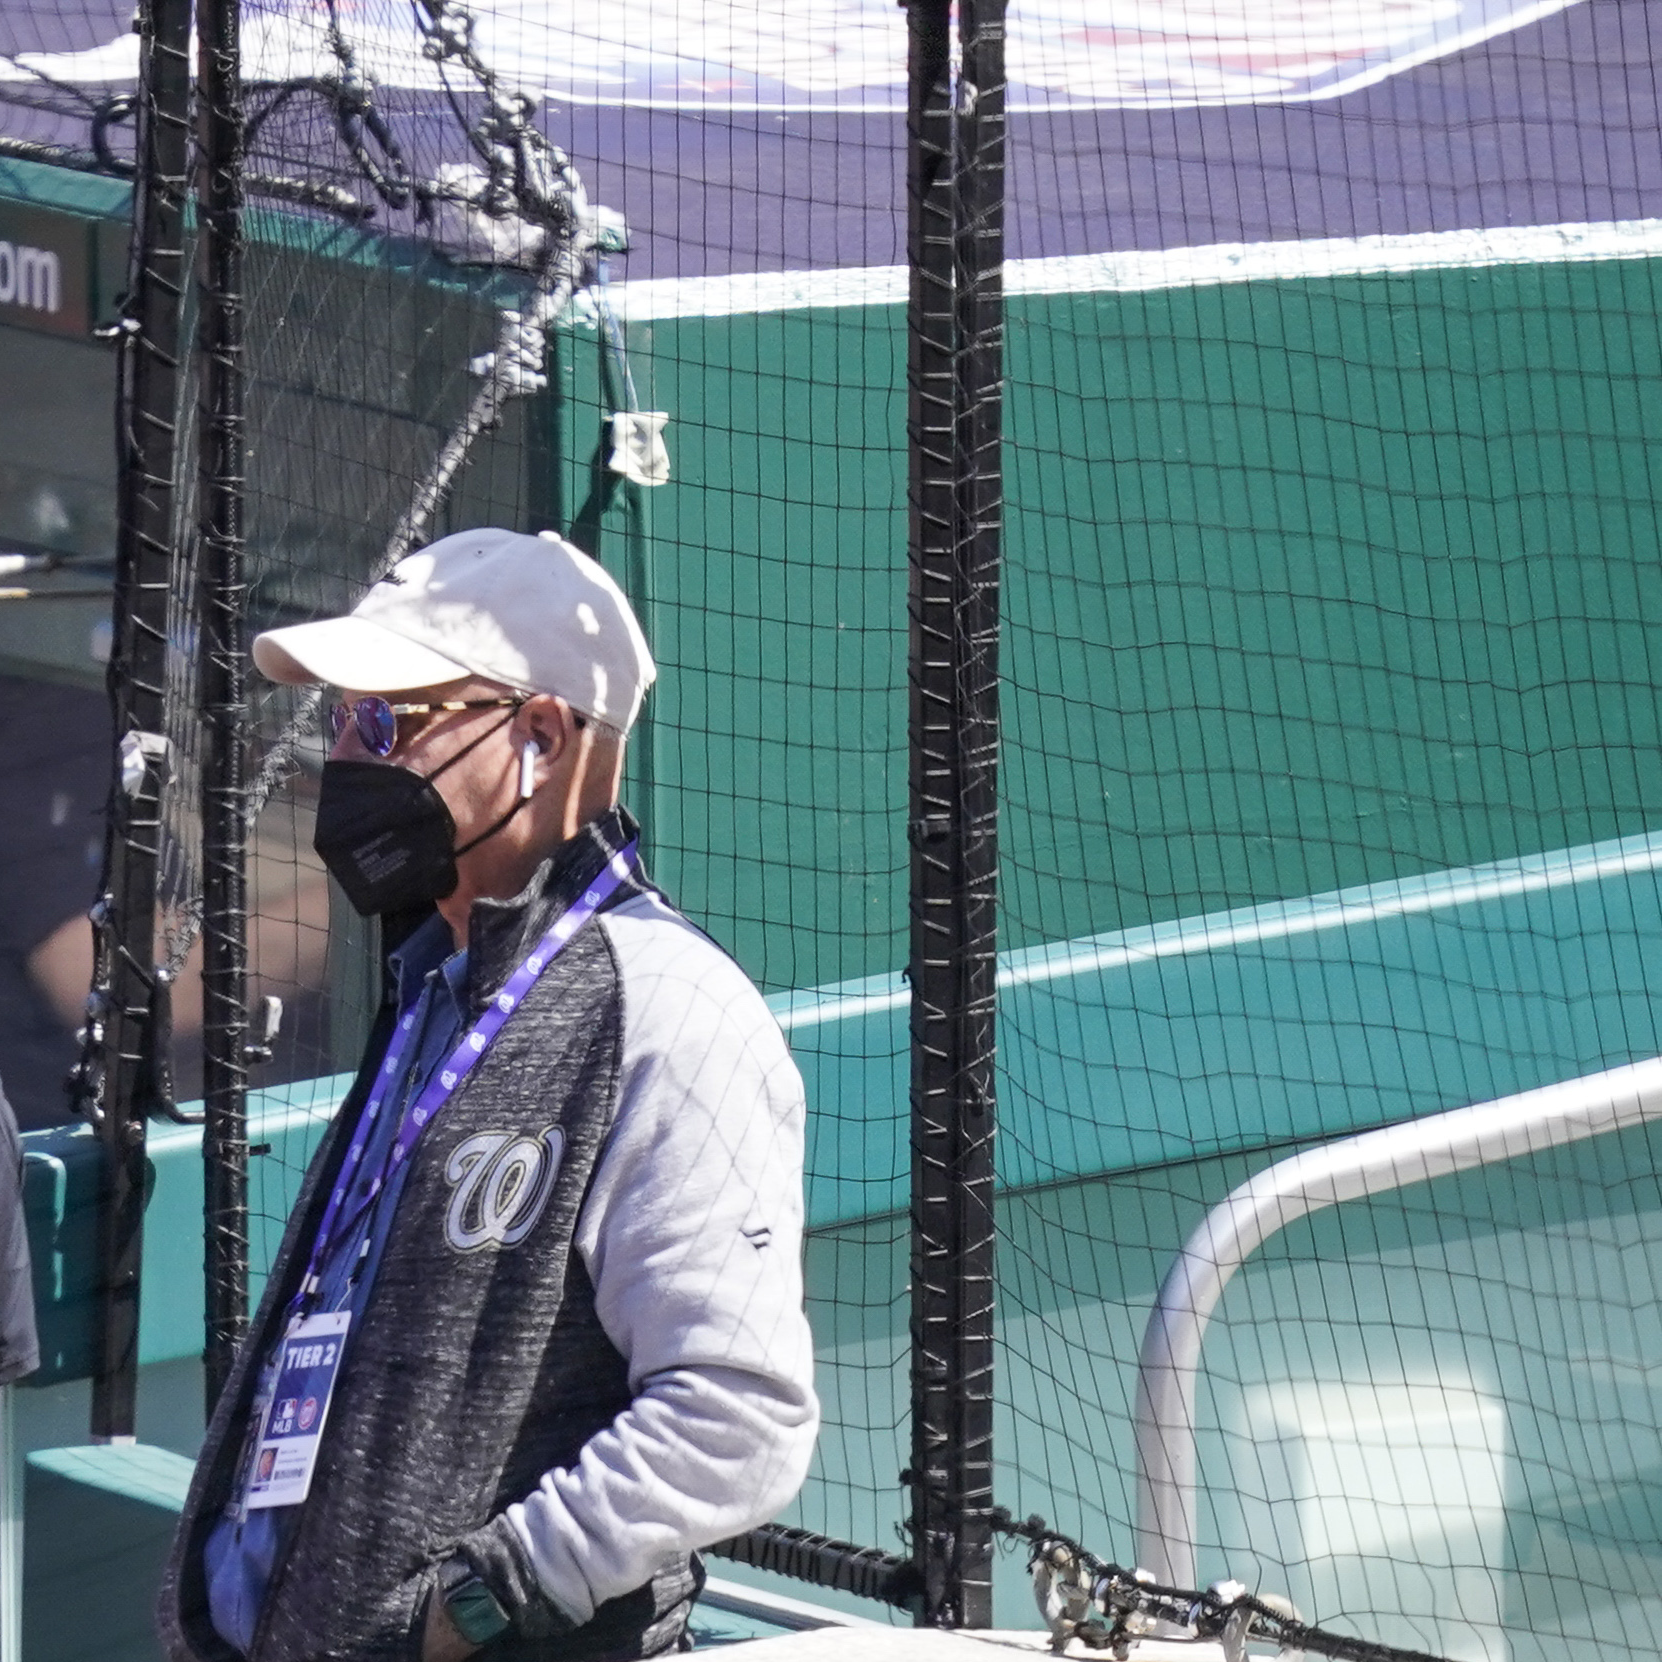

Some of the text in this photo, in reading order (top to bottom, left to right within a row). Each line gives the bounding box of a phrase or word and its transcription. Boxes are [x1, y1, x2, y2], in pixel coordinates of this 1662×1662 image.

[444, 1124, 566, 1254] W
[287, 1343, 336, 1370] TIER 2
[272, 1419, 293, 1434] MLB
